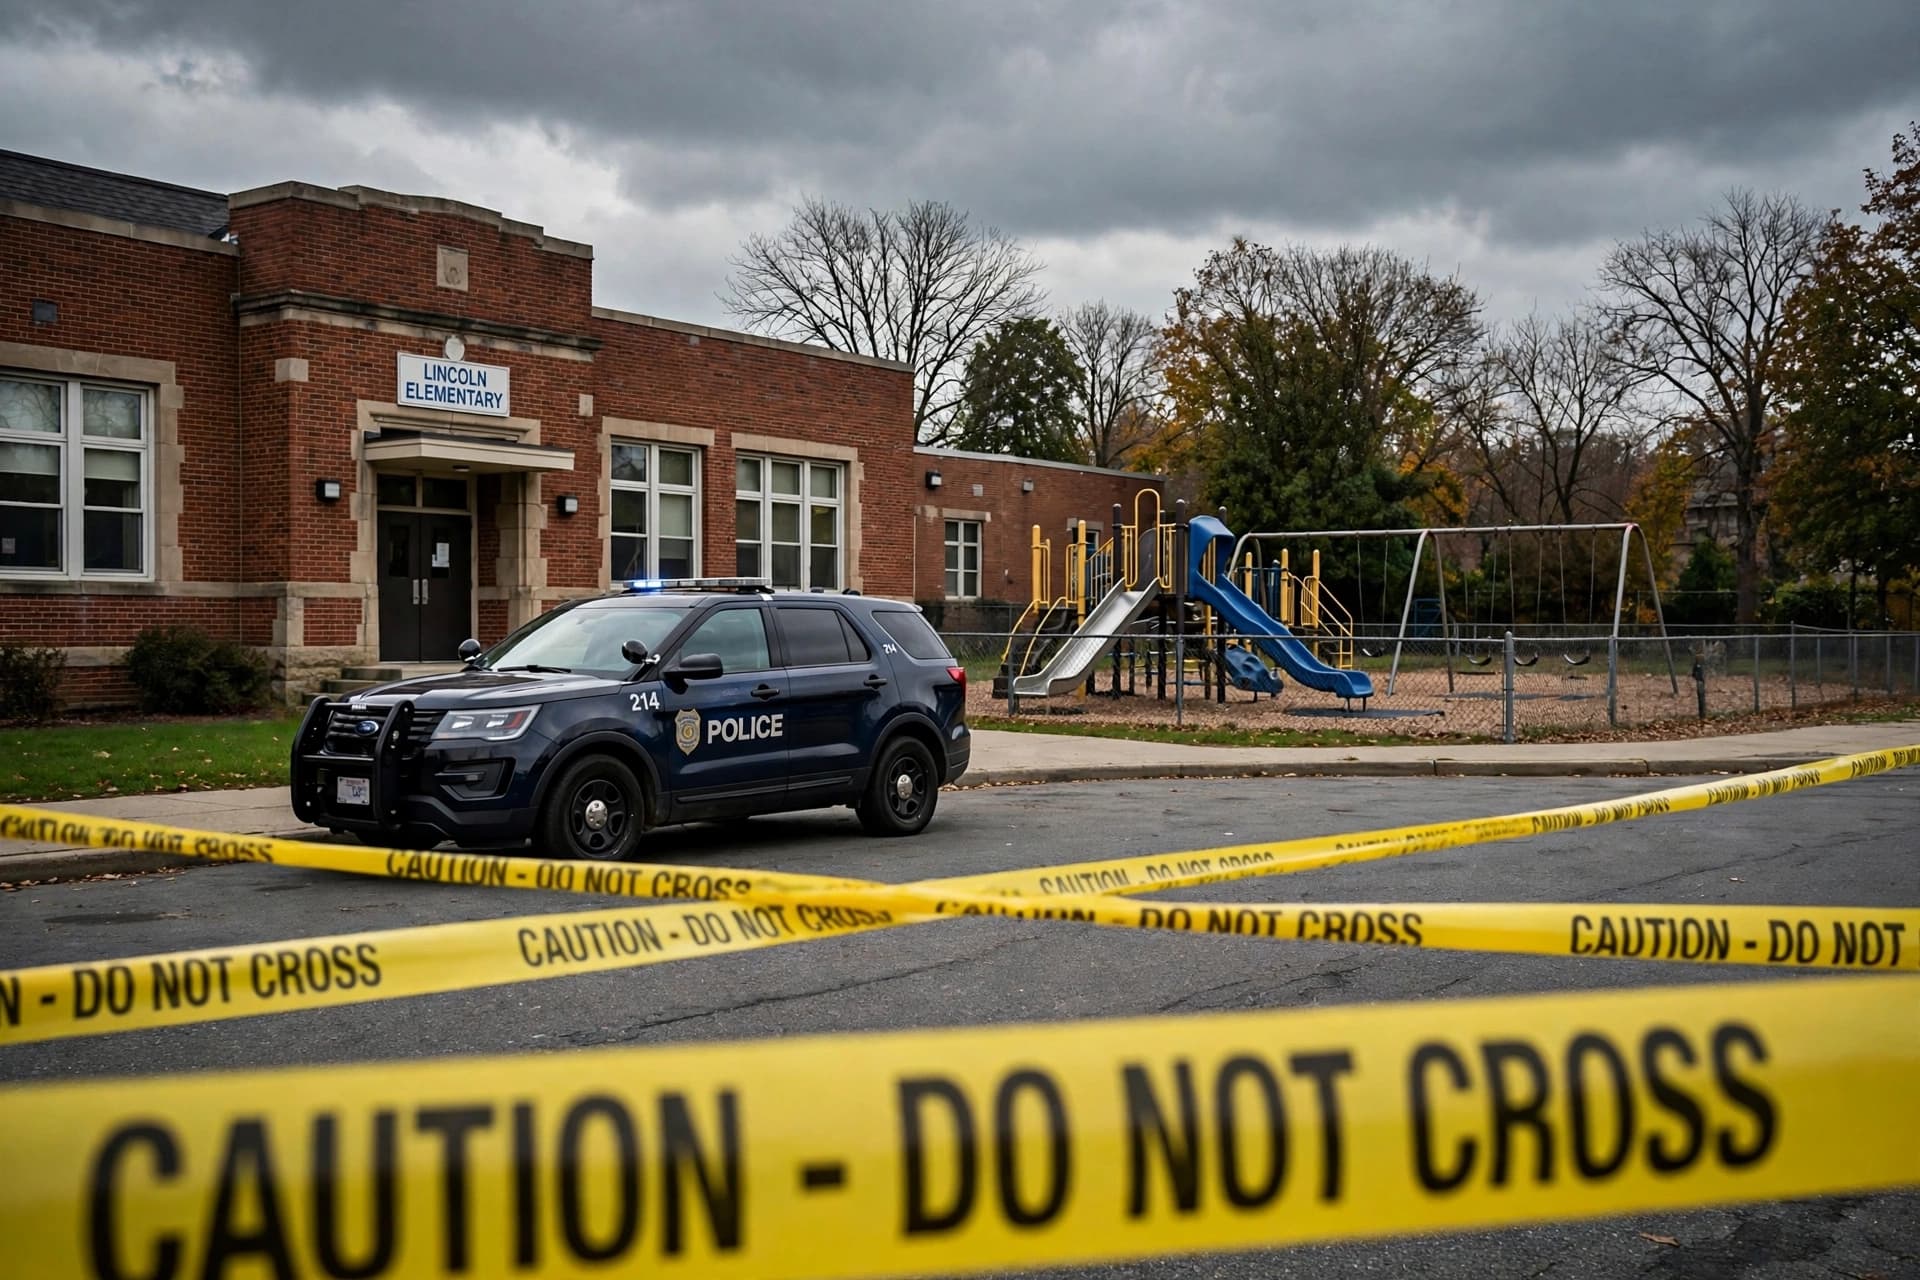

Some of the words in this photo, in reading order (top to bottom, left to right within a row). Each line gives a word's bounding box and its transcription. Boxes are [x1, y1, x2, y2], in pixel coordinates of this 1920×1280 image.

[424, 363, 487, 387] LINCOLN
[406, 382, 503, 408] ELEMENTARY
[630, 692, 660, 711] 214
[708, 714, 783, 744] POLICE
[584, 866, 642, 898] NOT
[517, 917, 664, 968] CAUTION
[683, 912, 733, 946] DO
[731, 904, 795, 940] NOT
[1207, 908, 1283, 937] NOT
[1296, 910, 1424, 945] CROSS
[1571, 914, 1730, 961] CAUTION
[1767, 919, 1820, 965] DO
[1832, 922, 1906, 968] NOT
[73, 965, 135, 1020] DO
[152, 955, 235, 1013] NOT
[251, 943, 382, 1000] CROSS
[82, 1087, 748, 1280] CAUTION
[898, 1066, 1075, 1239] DO
[1122, 1048, 1358, 1222] NOT
[1407, 1020, 1780, 1196] CROSS
